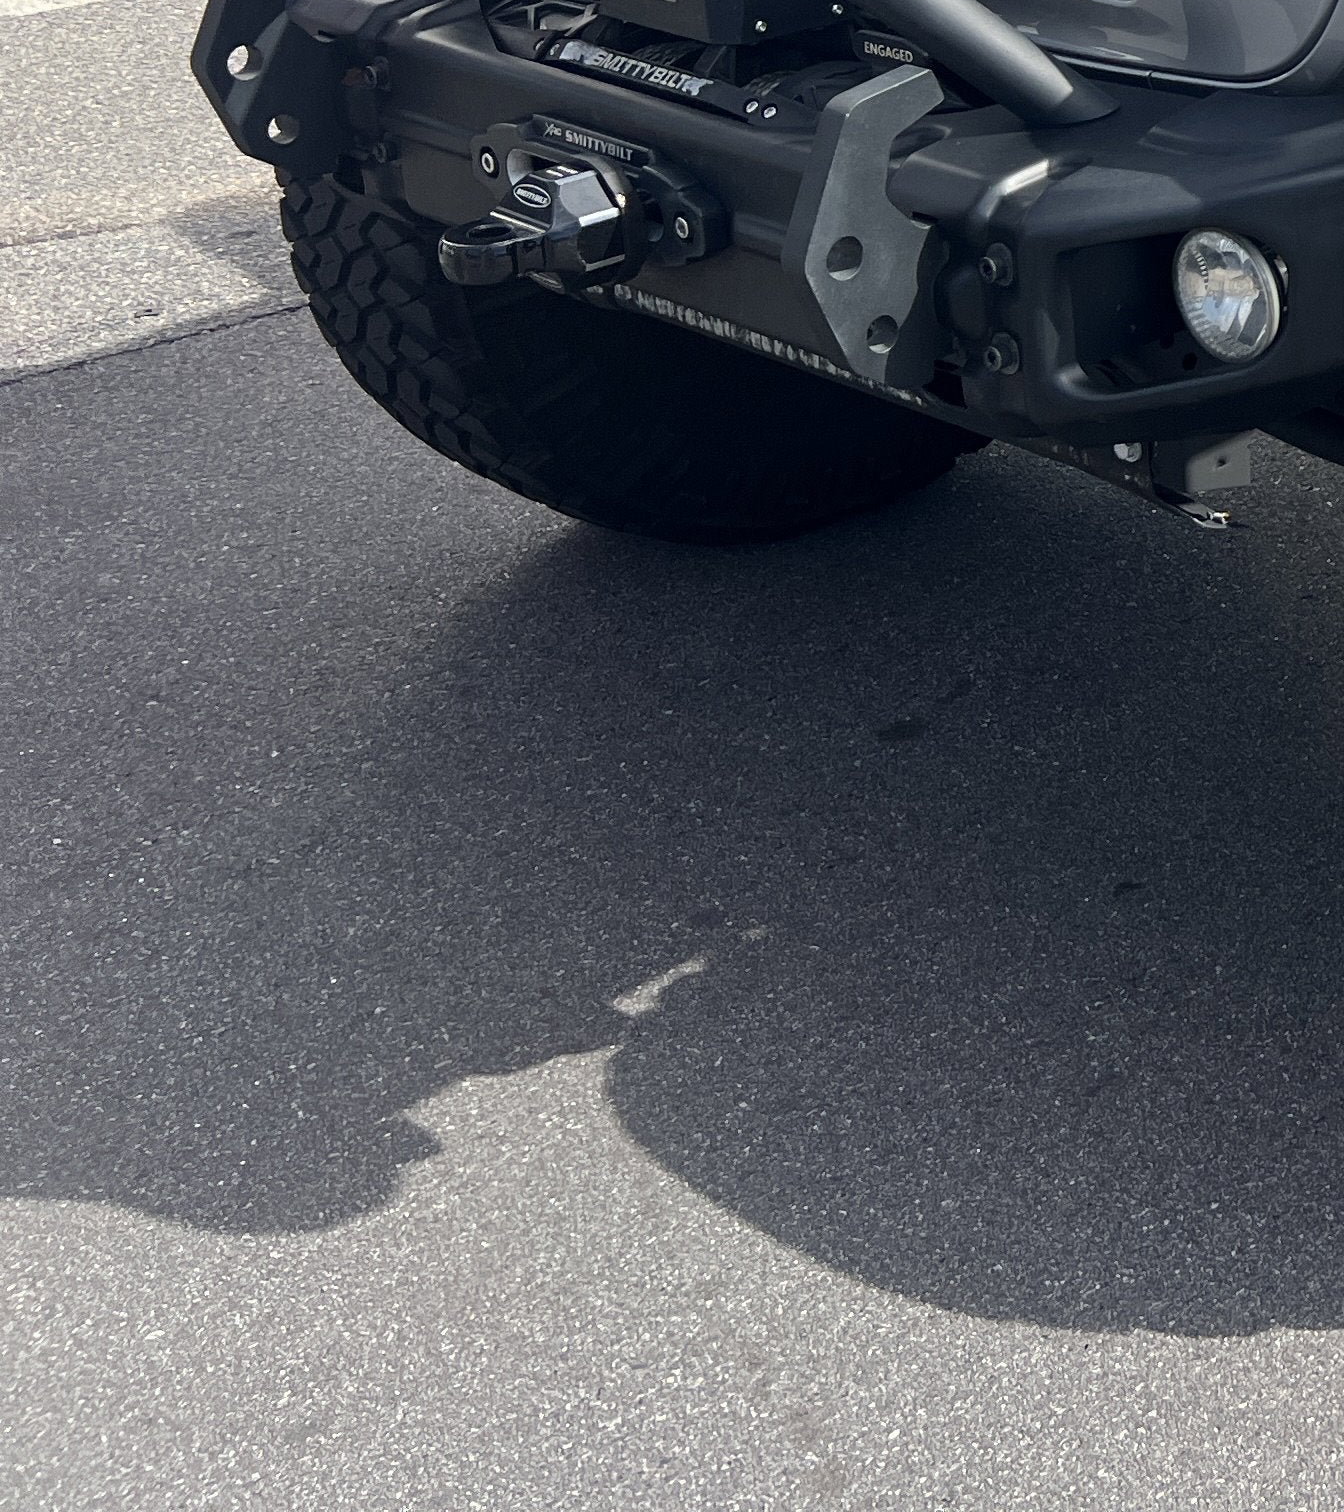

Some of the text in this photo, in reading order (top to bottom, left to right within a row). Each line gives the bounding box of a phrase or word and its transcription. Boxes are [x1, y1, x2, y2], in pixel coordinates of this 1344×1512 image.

[862, 40, 914, 63] ENGAGED
[595, 50, 688, 90] SMITTYBILT
[565, 129, 633, 161] SMITTYBILT
